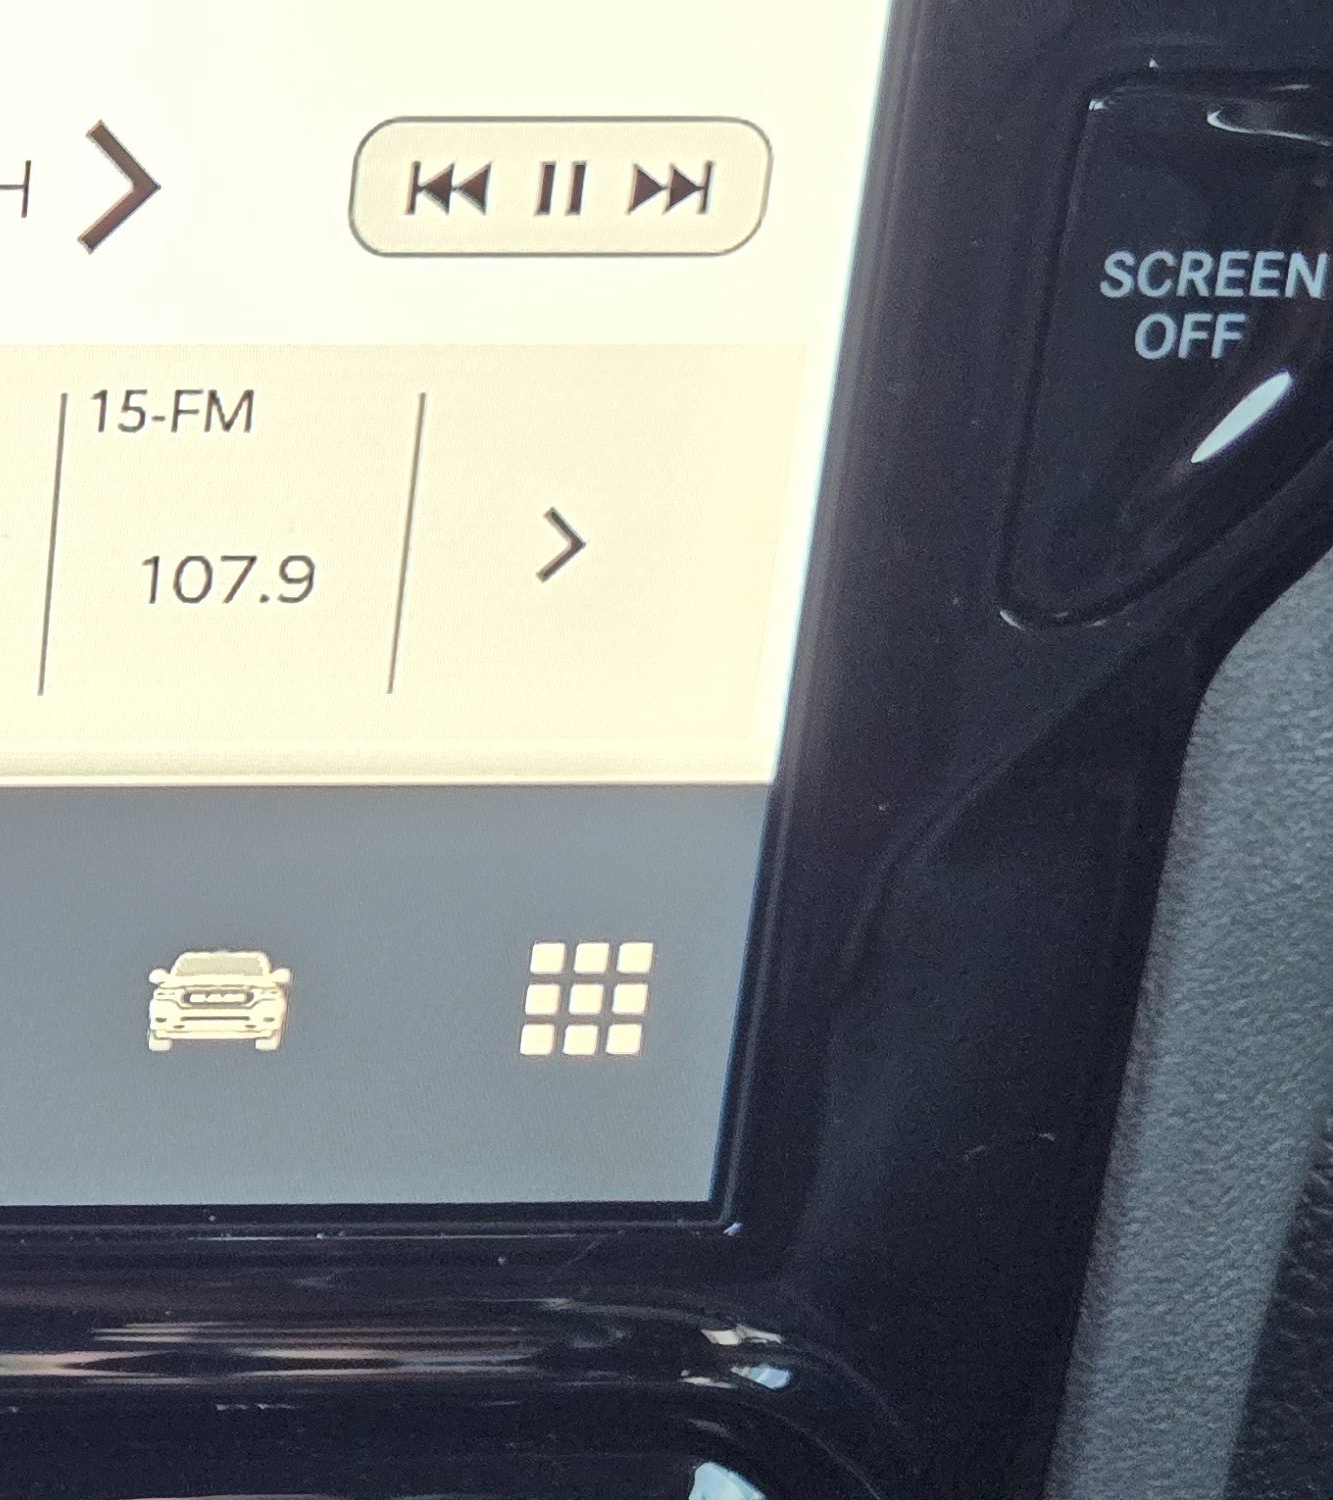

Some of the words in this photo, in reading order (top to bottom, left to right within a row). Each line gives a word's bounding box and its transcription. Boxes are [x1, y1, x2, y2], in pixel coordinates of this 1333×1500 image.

[1099, 250, 1329, 299] SCREEN
[1135, 312, 1246, 360] OFF
[90, 388, 256, 434] 15-FM
[139, 556, 315, 605] 107.9
